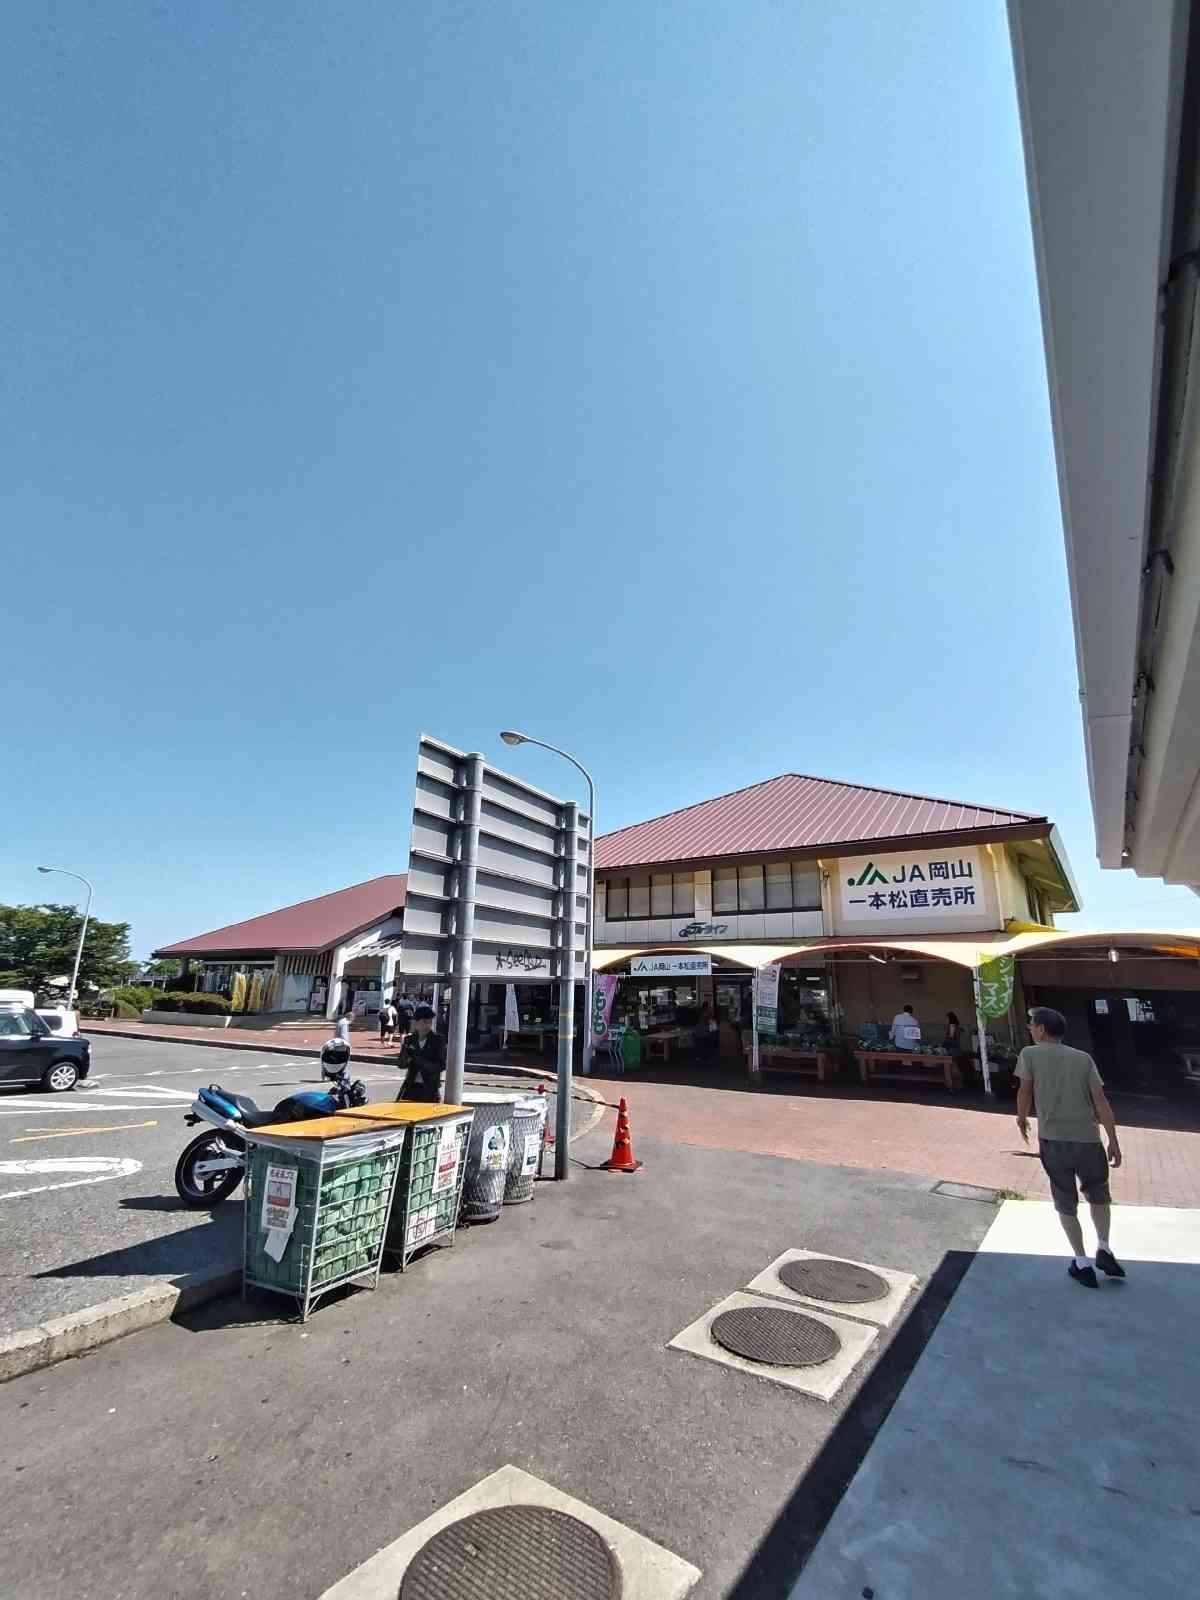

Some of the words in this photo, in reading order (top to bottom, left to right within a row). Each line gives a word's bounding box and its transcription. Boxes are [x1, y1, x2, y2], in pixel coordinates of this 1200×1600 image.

[892, 859, 973, 884] JA岡山
[849, 886, 976, 910] 一本松直売所
